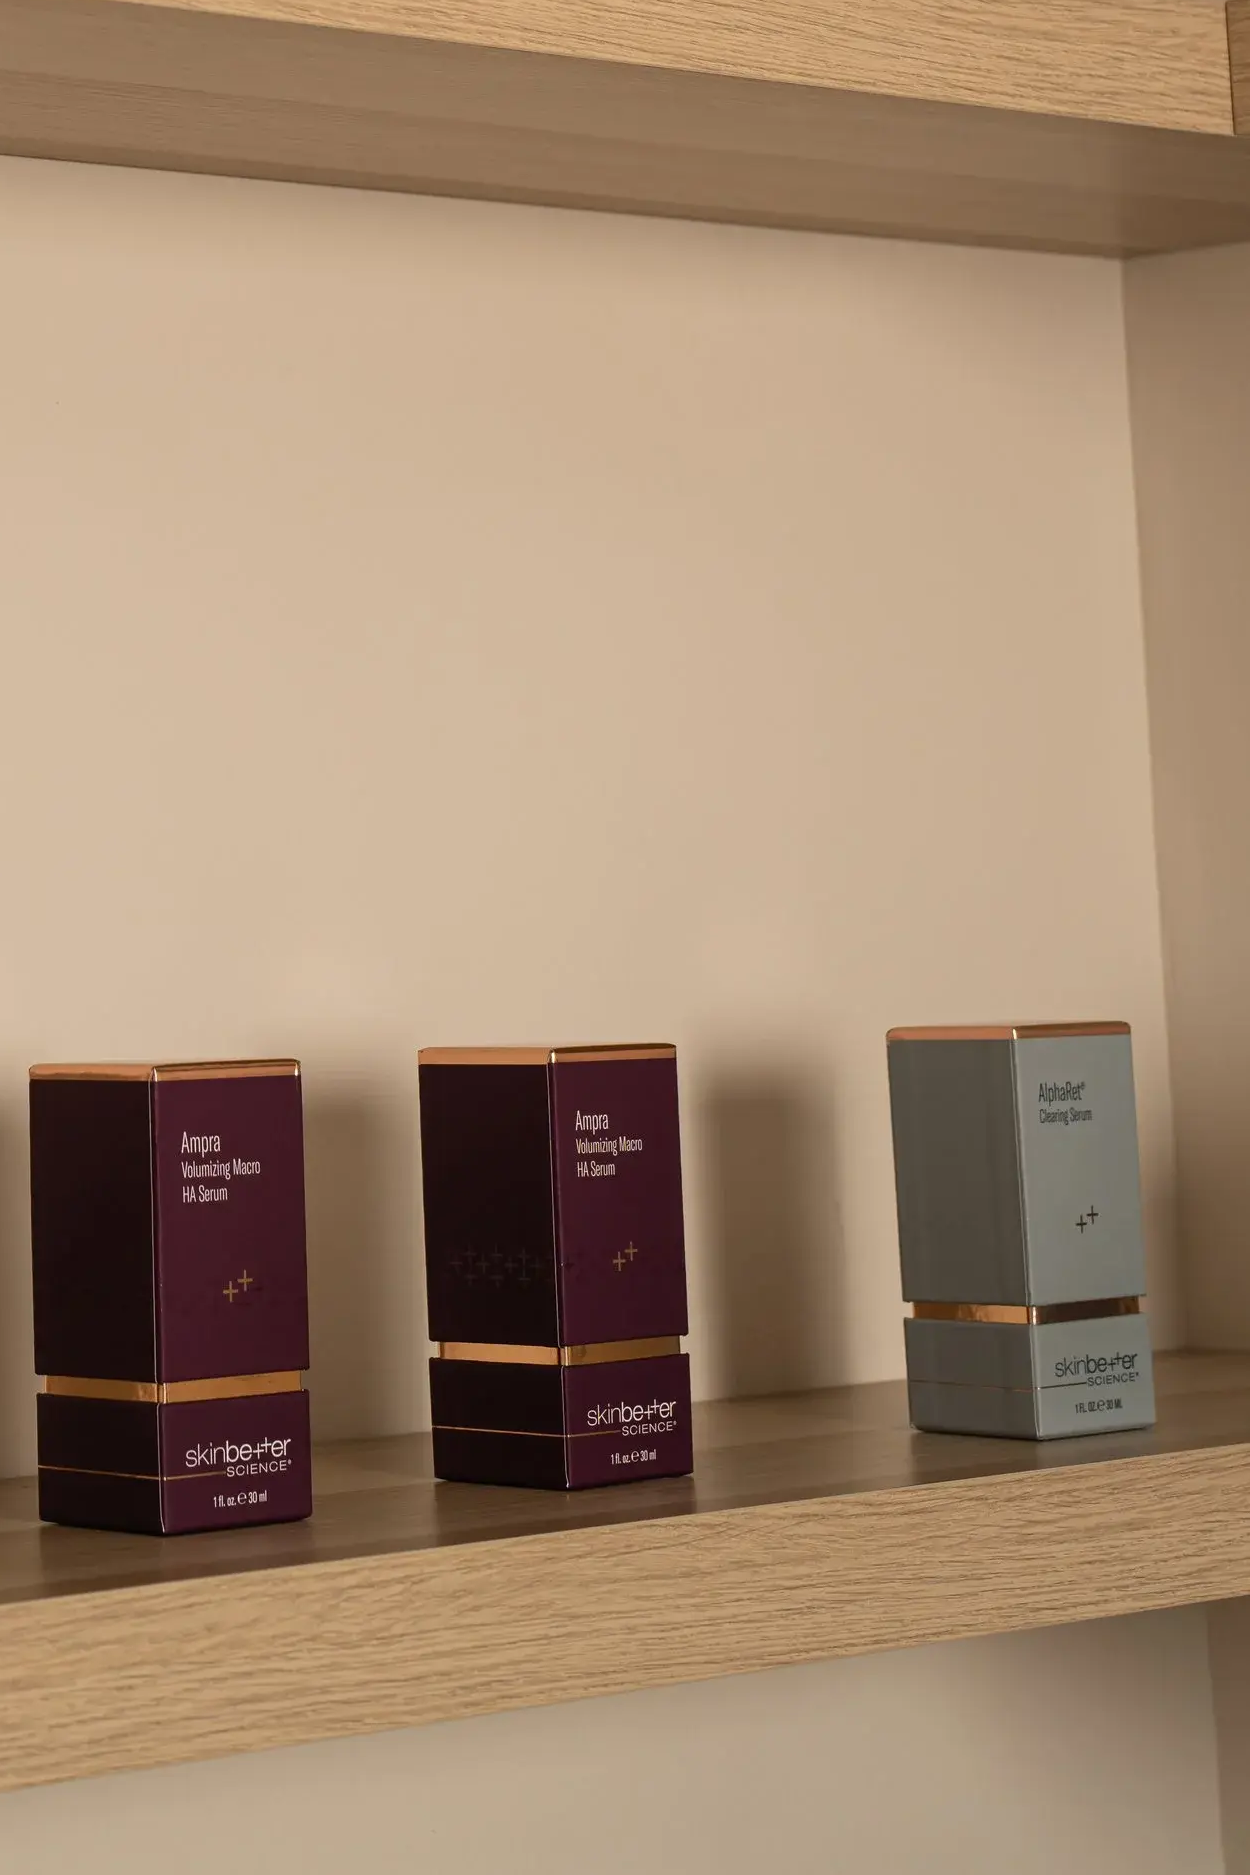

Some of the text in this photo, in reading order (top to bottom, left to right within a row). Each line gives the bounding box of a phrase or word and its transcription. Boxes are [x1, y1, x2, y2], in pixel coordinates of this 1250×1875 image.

[576, 1110, 609, 1135] Ampra
[1039, 1107, 1093, 1125] Clearing Serum
[181, 1131, 221, 1158] Ampra
[576, 1136, 643, 1156] Volumizing Macro
[181, 1158, 261, 1180] Volumizing Macro
[577, 1161, 616, 1178] HA Serum
[182, 1185, 228, 1203] HA Serum
[640, 1450, 648, 1461] 30
[649, 1449, 657, 1460] ml
[248, 1491, 258, 1503] 30
[259, 1490, 267, 1502] ml
